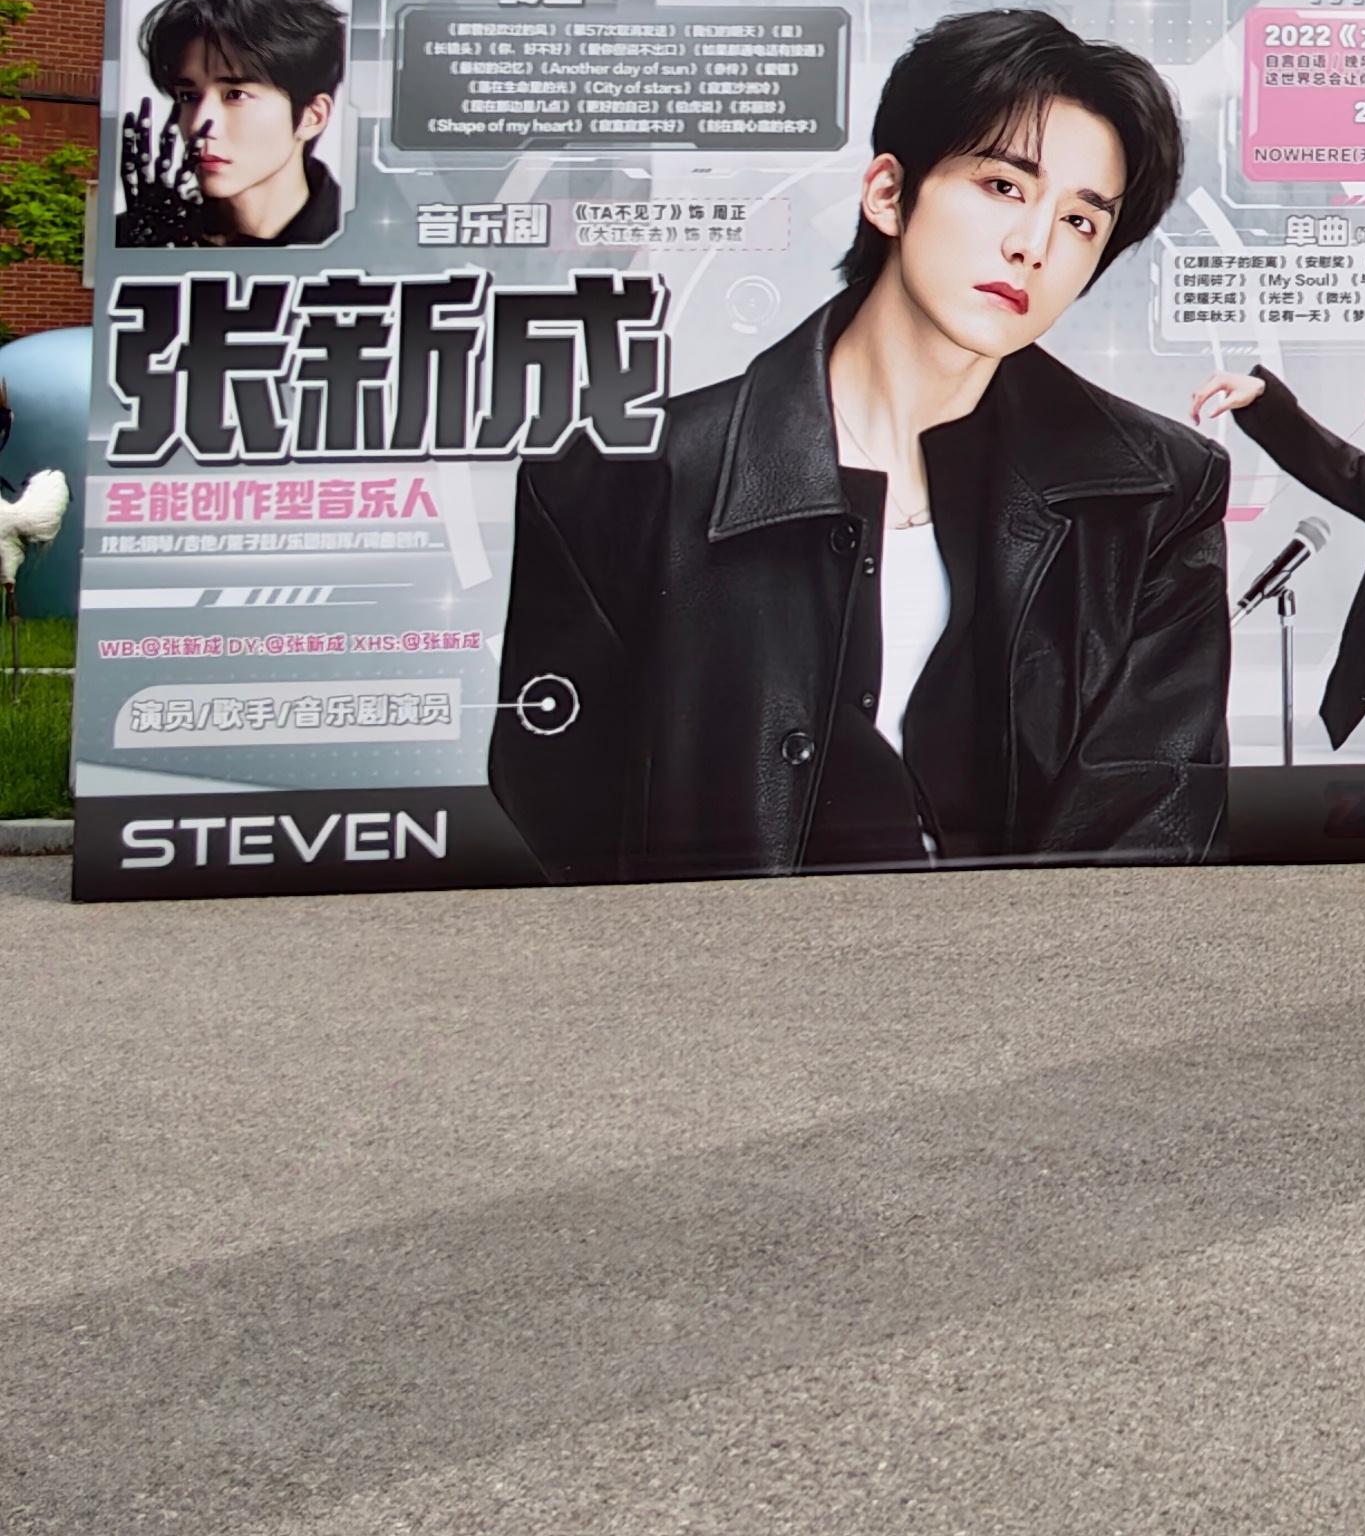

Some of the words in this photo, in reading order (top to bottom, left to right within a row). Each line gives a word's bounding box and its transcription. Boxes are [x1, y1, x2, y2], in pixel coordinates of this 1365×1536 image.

[642, 62, 659, 75] of
[624, 81, 641, 94] of
[487, 118, 505, 133] of
[506, 122, 531, 135] my
[417, 202, 550, 246] 音乐剧
[576, 204, 682, 221] 《TA不见了》
[1284, 214, 1349, 247] 单曲
[107, 268, 672, 463] 张新成
[105, 477, 439, 523] 全能创作型音乐人
[100, 636, 223, 658] WB:@张新成
[229, 633, 346, 655] DY:@张新成
[353, 630, 482, 653] XHS:@张新成
[130, 693, 452, 733] 演员/歌手/音乐剧演员
[121, 810, 448, 869] STEVEN
